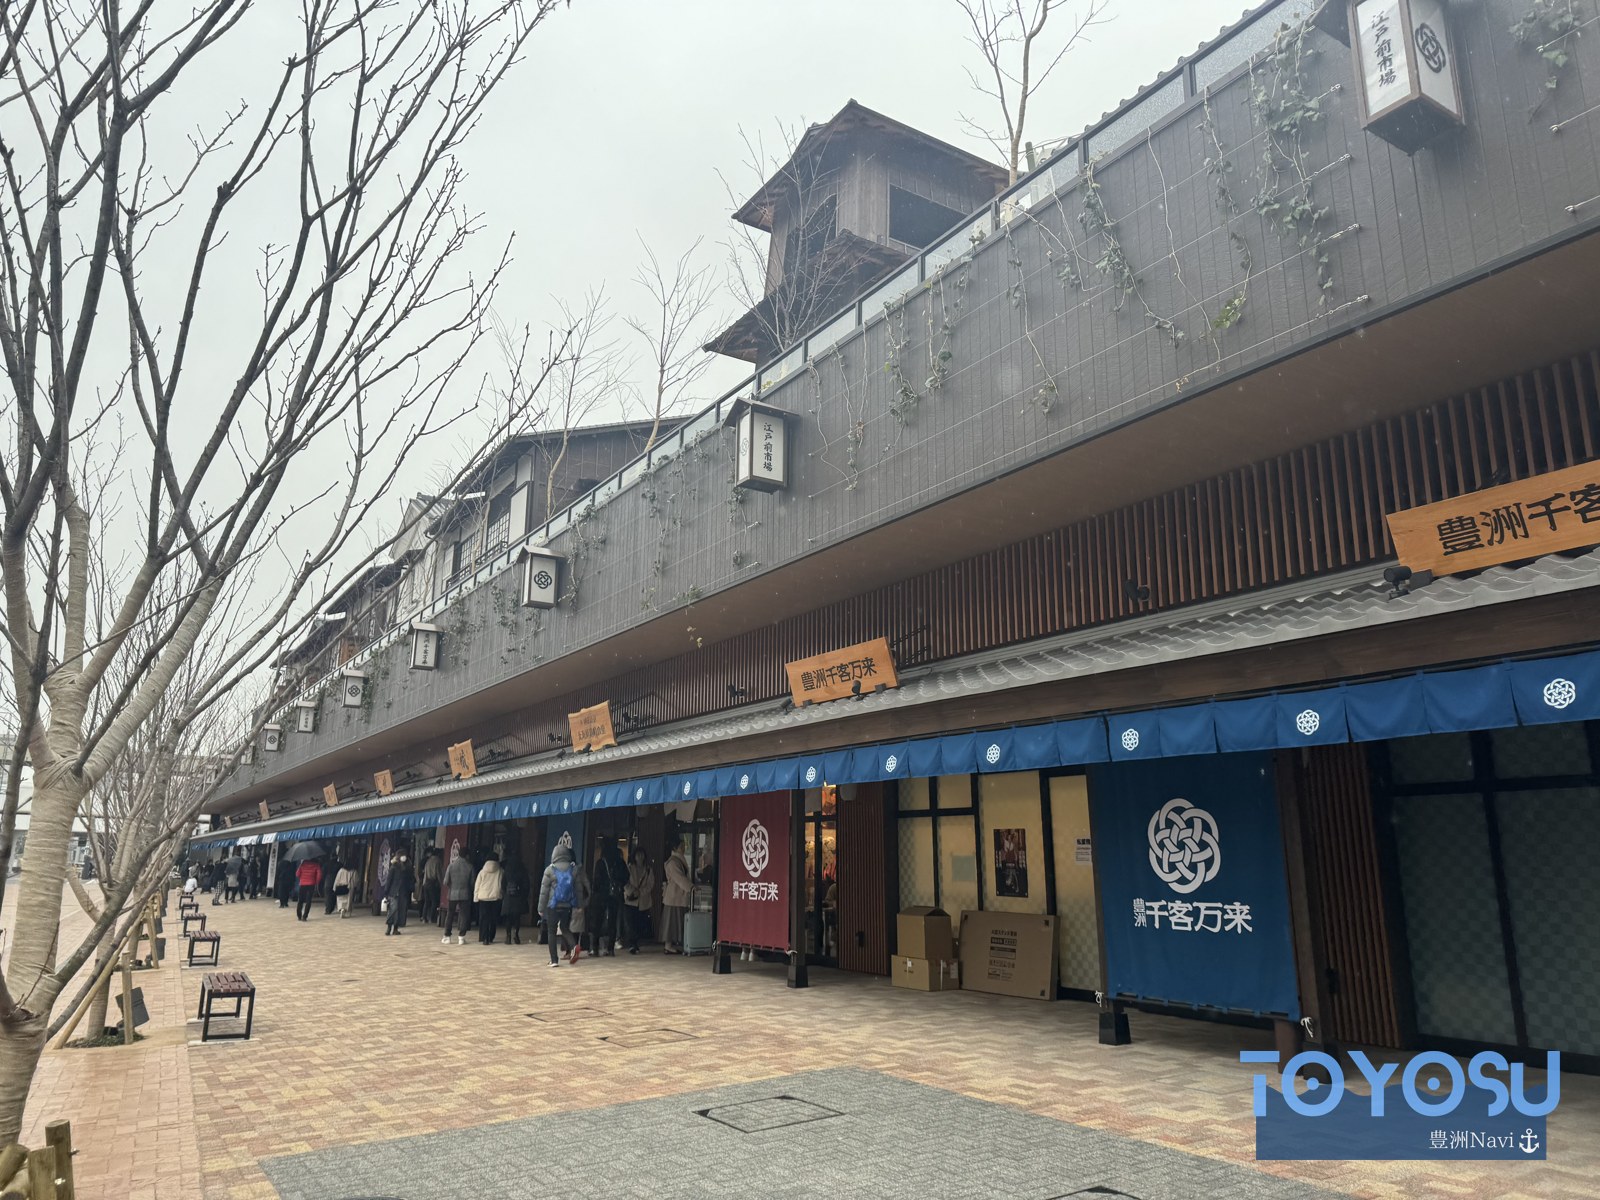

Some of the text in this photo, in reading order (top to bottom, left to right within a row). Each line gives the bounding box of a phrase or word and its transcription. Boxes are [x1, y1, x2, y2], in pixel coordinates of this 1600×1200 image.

[1371, 10, 1397, 88] 江戸前市場
[763, 422, 774, 472] 江戸前市場
[801, 657, 877, 691] 豊洲千客万来
